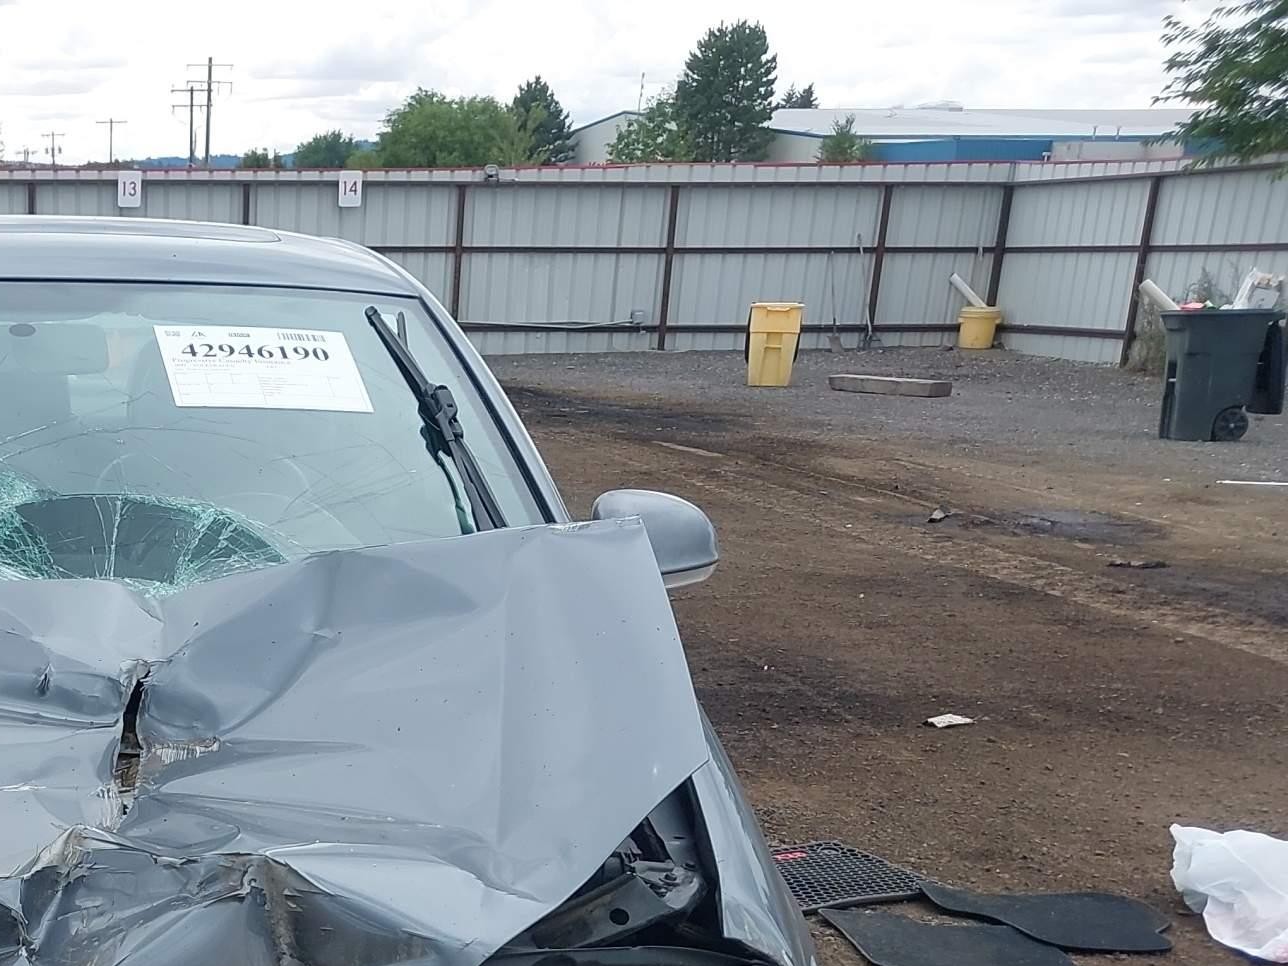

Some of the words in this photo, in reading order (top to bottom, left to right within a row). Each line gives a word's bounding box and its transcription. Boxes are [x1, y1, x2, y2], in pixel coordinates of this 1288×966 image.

[122, 181, 137, 197] 13
[343, 180, 358, 196] 14
[181, 343, 330, 362] 42946190
